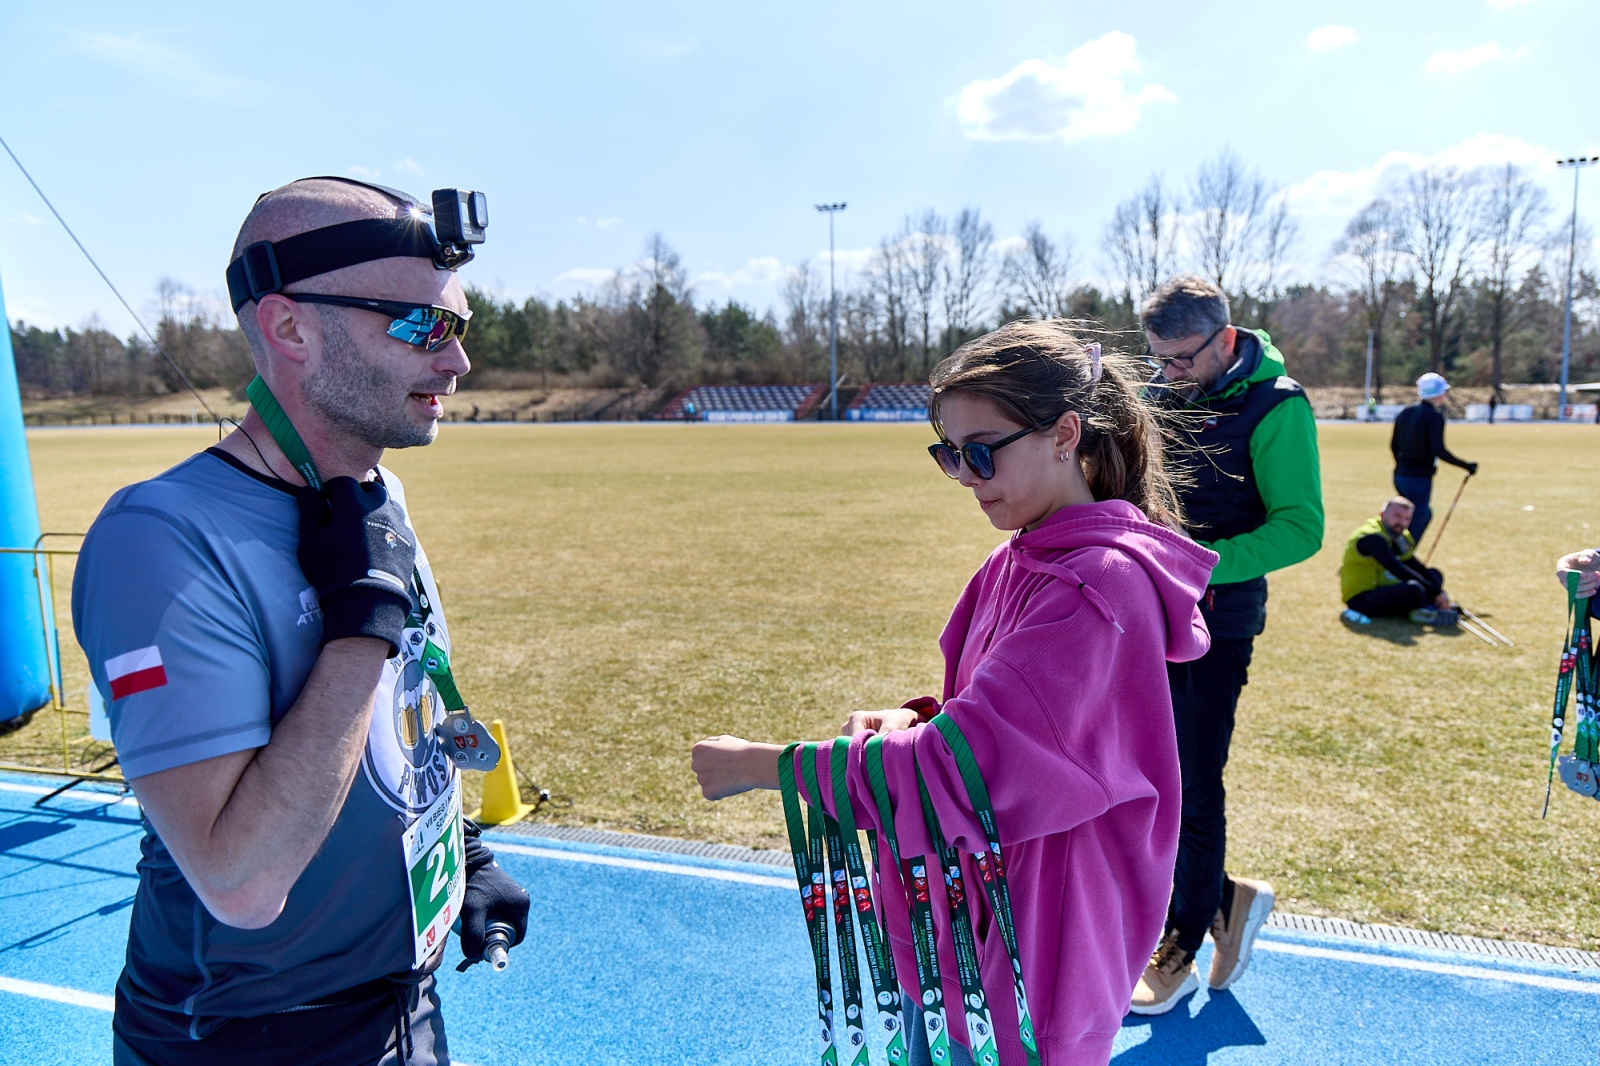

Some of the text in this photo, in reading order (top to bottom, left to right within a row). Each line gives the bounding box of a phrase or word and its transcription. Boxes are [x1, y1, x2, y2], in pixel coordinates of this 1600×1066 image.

[432, 803, 446, 822] BIEG
[862, 923, 872, 946] WALKING
[867, 946, 877, 965] NORDIC
[930, 953, 938, 977] WALKING
[872, 967, 880, 979] BIEG
